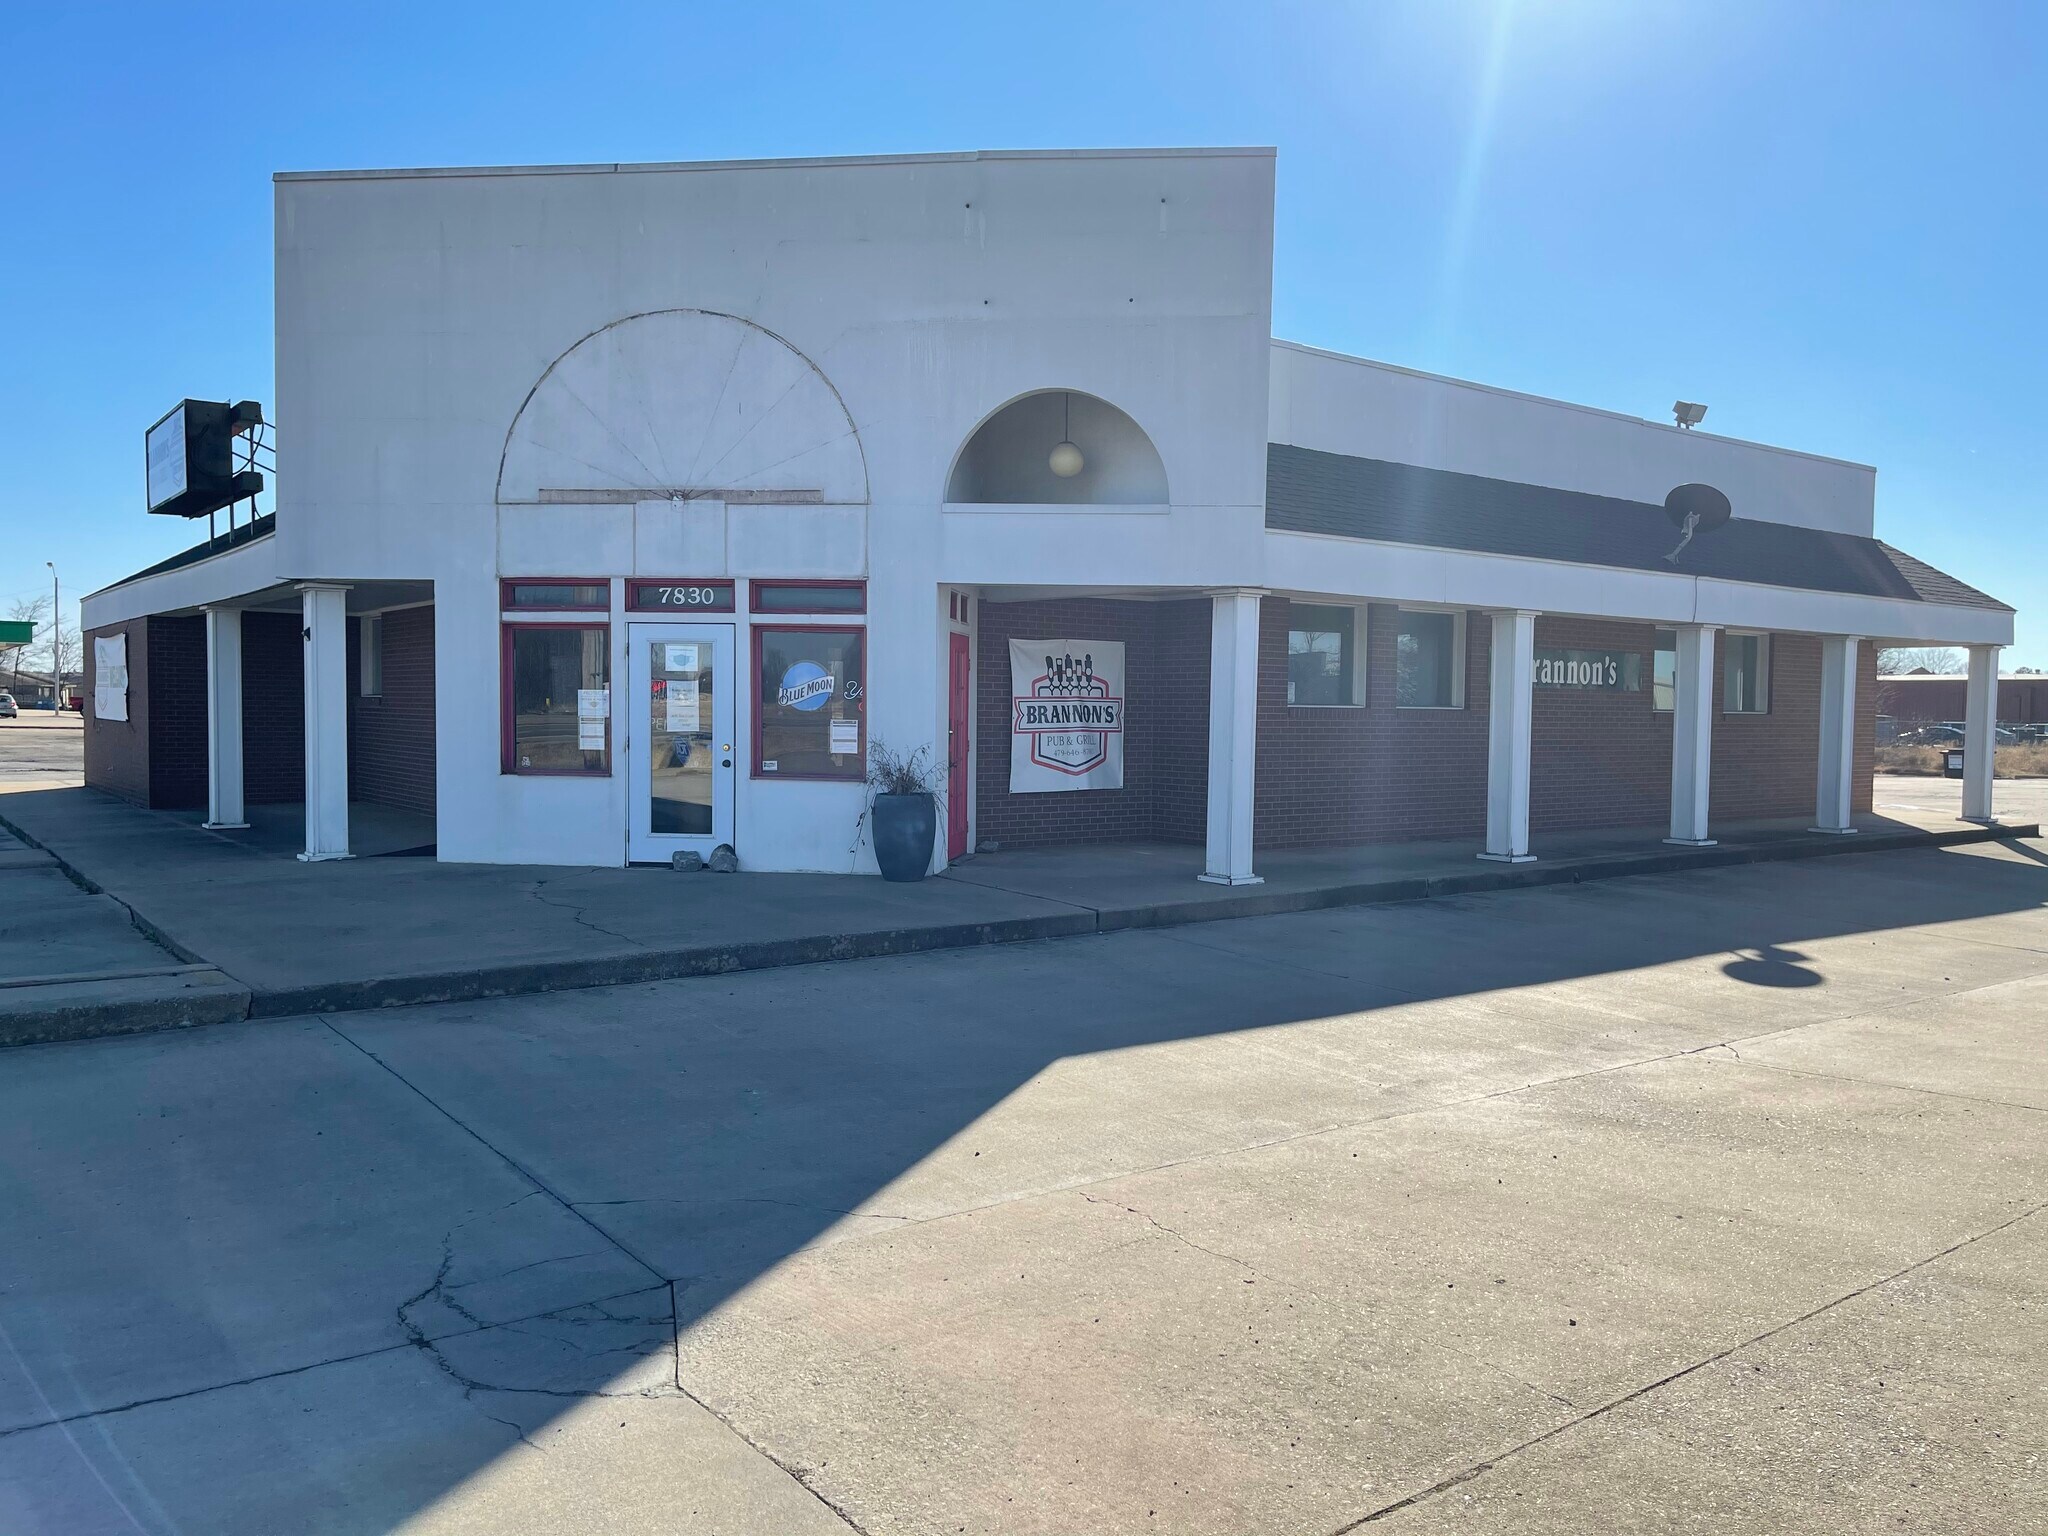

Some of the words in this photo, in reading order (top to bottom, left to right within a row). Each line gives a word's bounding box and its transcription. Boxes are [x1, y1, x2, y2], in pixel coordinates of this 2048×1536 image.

[659, 587, 714, 605] 7830
[1532, 655, 1617, 685] rannon's
[779, 687, 806, 705] BLUE
[806, 679, 833, 696] MOON
[1026, 704, 1114, 724] BRANNON'S
[1046, 735, 1065, 747] PUB
[1066, 735, 1074, 746] &
[1076, 734, 1097, 746] GRILL
